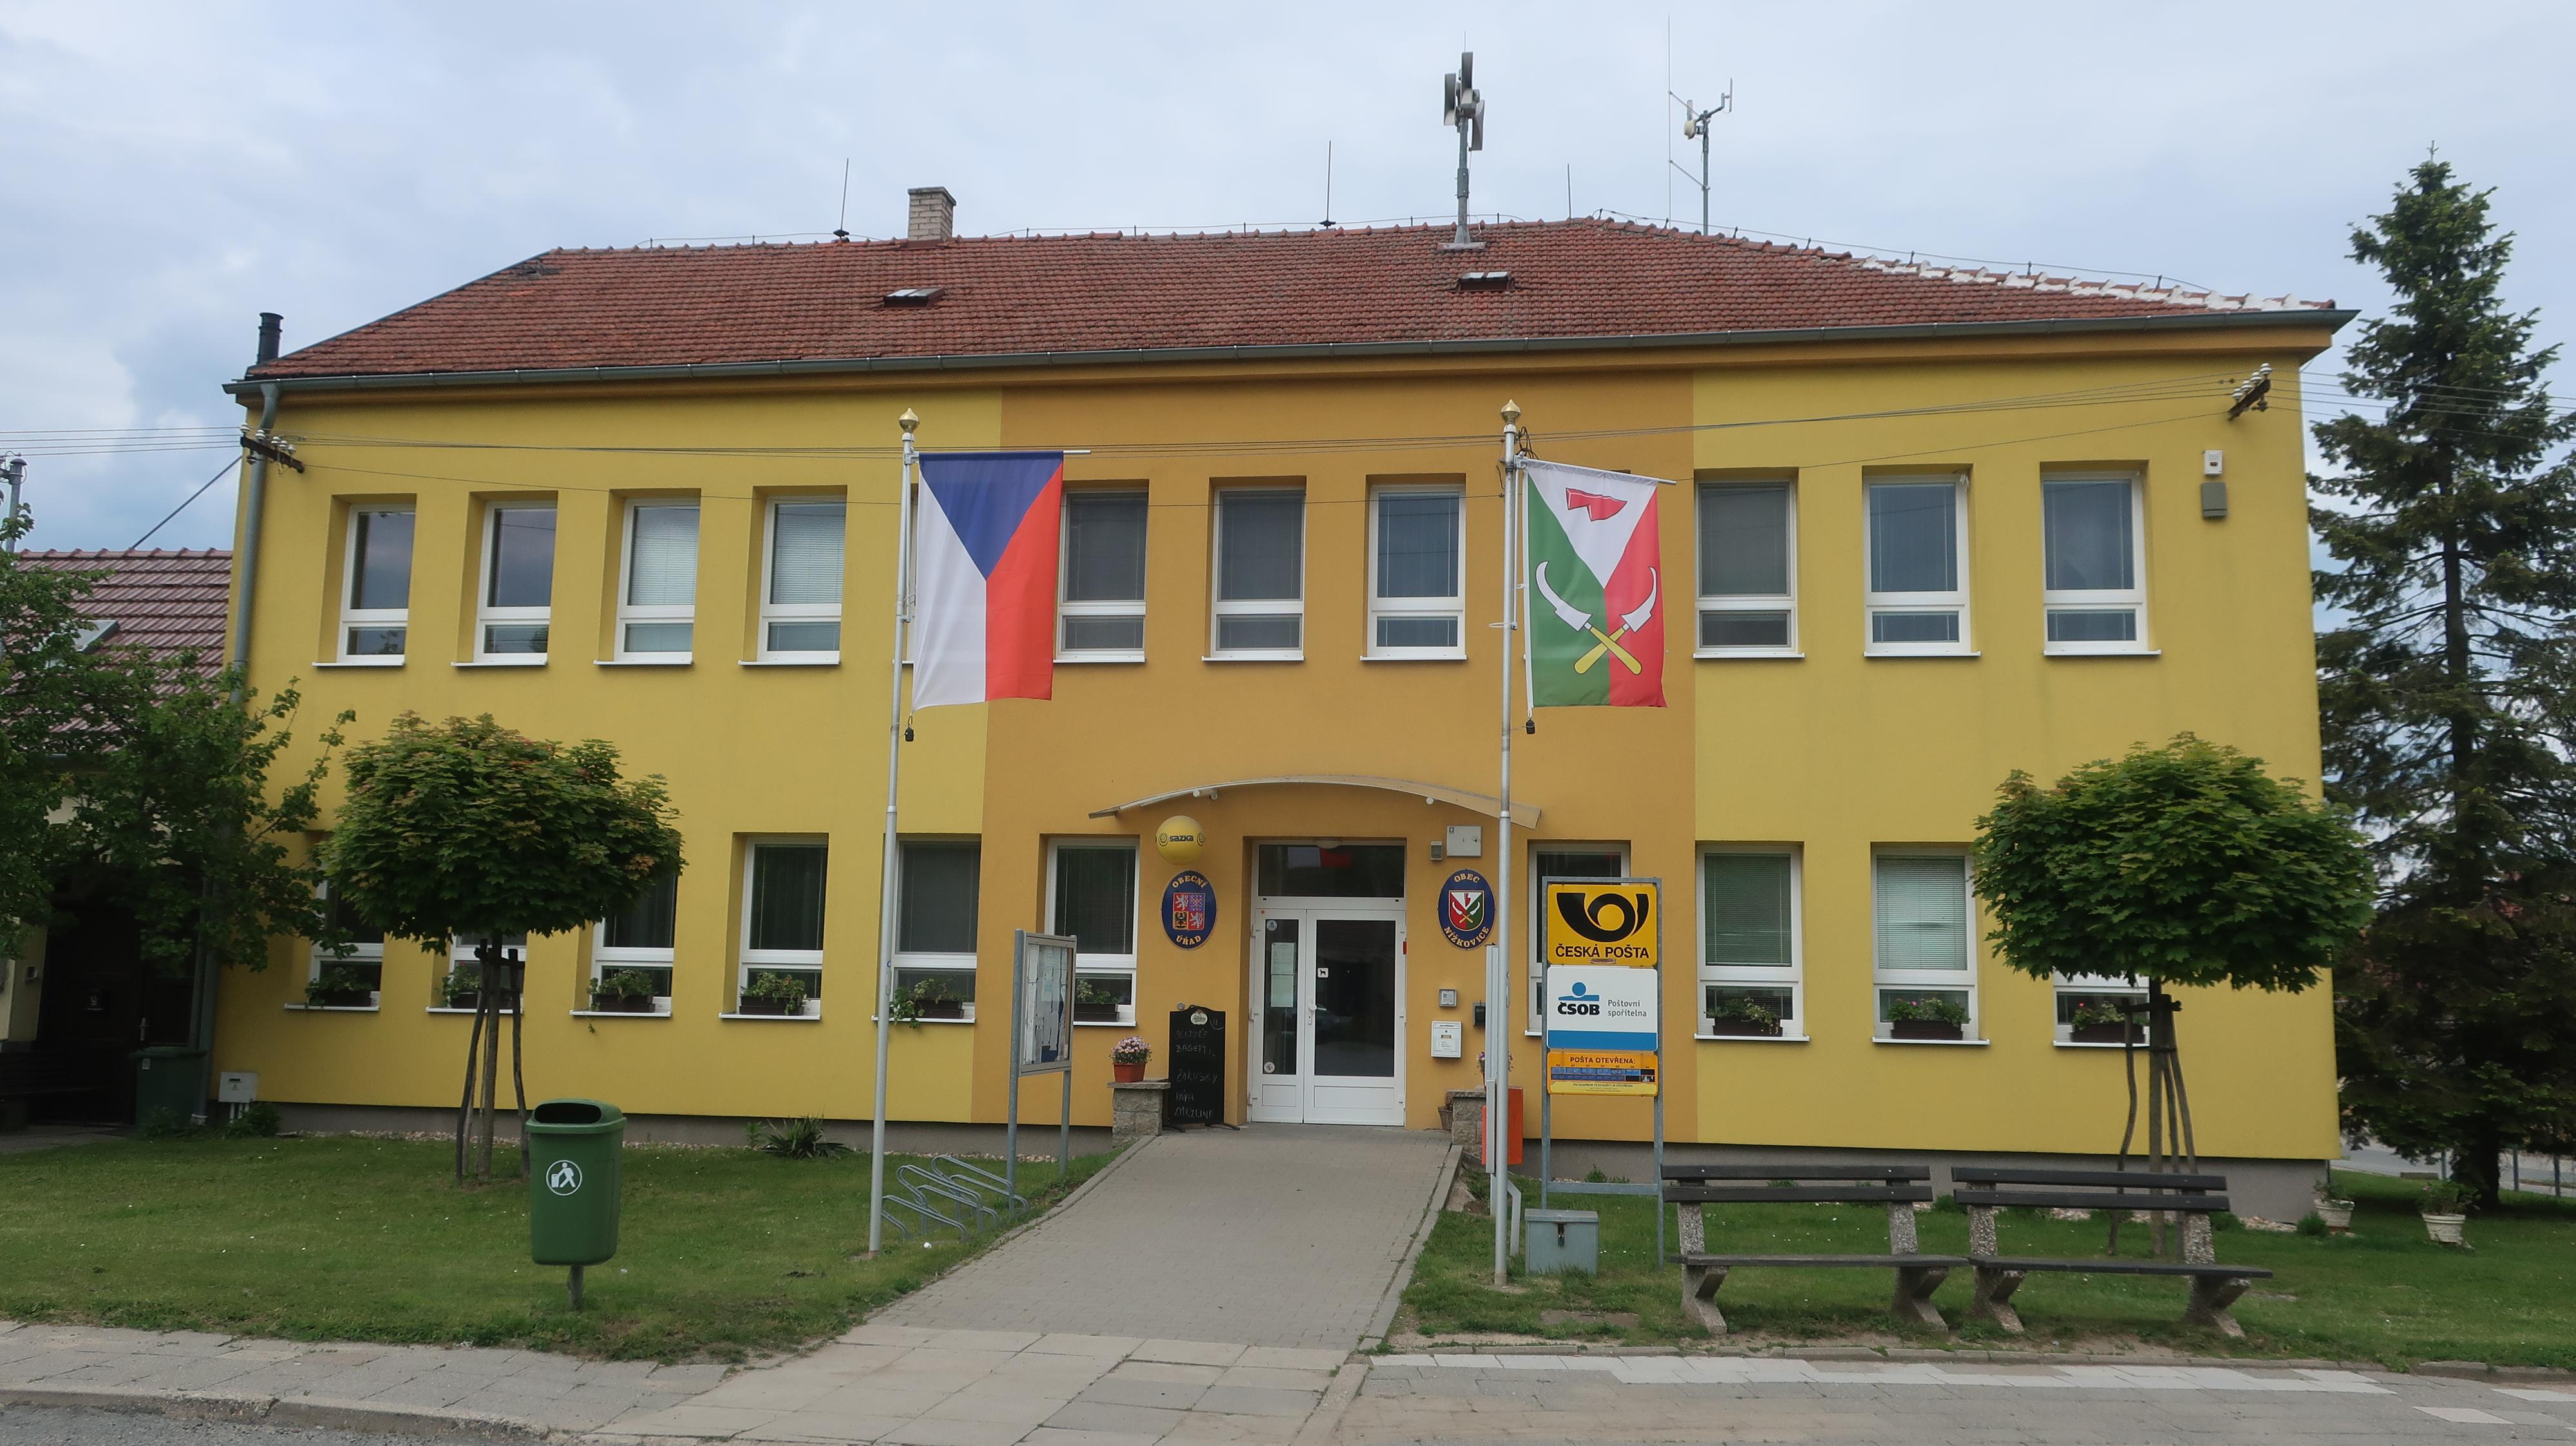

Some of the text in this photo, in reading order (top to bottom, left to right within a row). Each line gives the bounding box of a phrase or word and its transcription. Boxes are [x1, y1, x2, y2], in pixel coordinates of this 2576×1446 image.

[1171, 875, 1208, 889] OBECNÍ
[1454, 873, 1480, 883] OBEC
[1176, 935, 1201, 945] ÚŘAD
[1444, 926, 1490, 947] NÍŽKOVICE
[1555, 943, 1649, 958] ČESKÁ POŠTA
[1557, 1002, 1600, 1016] ČSOB
[1607, 1009, 1647, 1018] spořitelna
